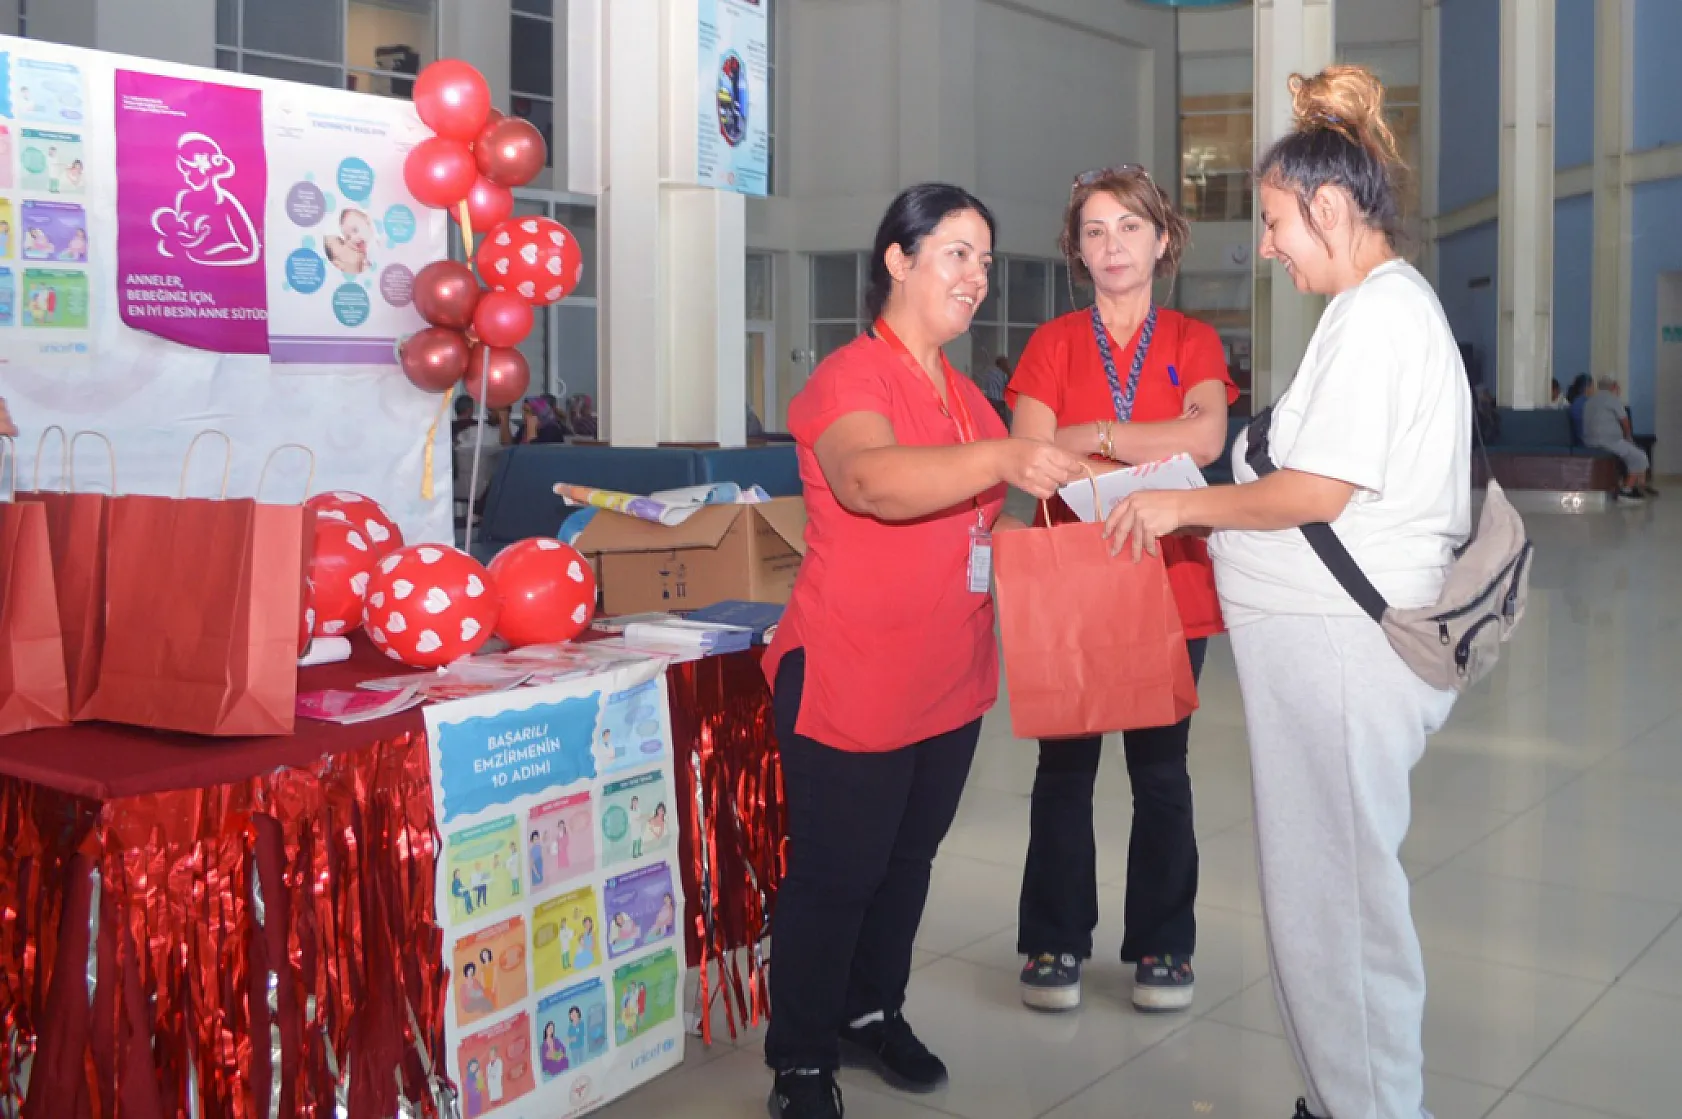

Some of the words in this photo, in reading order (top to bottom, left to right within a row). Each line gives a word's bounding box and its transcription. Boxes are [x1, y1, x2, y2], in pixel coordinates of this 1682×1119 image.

[126, 274, 184, 288] ANNELER,
[127, 289, 188, 302] BEBEĞİNİZ
[190, 290, 216, 305] İÇİN,
[128, 305, 145, 316] EN
[147, 304, 162, 316] İYİ
[164, 306, 197, 318] BESİN
[199, 308, 230, 319] ANNE
[474, 737, 561, 773] EMZİRMENİN
[492, 772, 508, 788] 10
[512, 759, 551, 783] ADIMI
